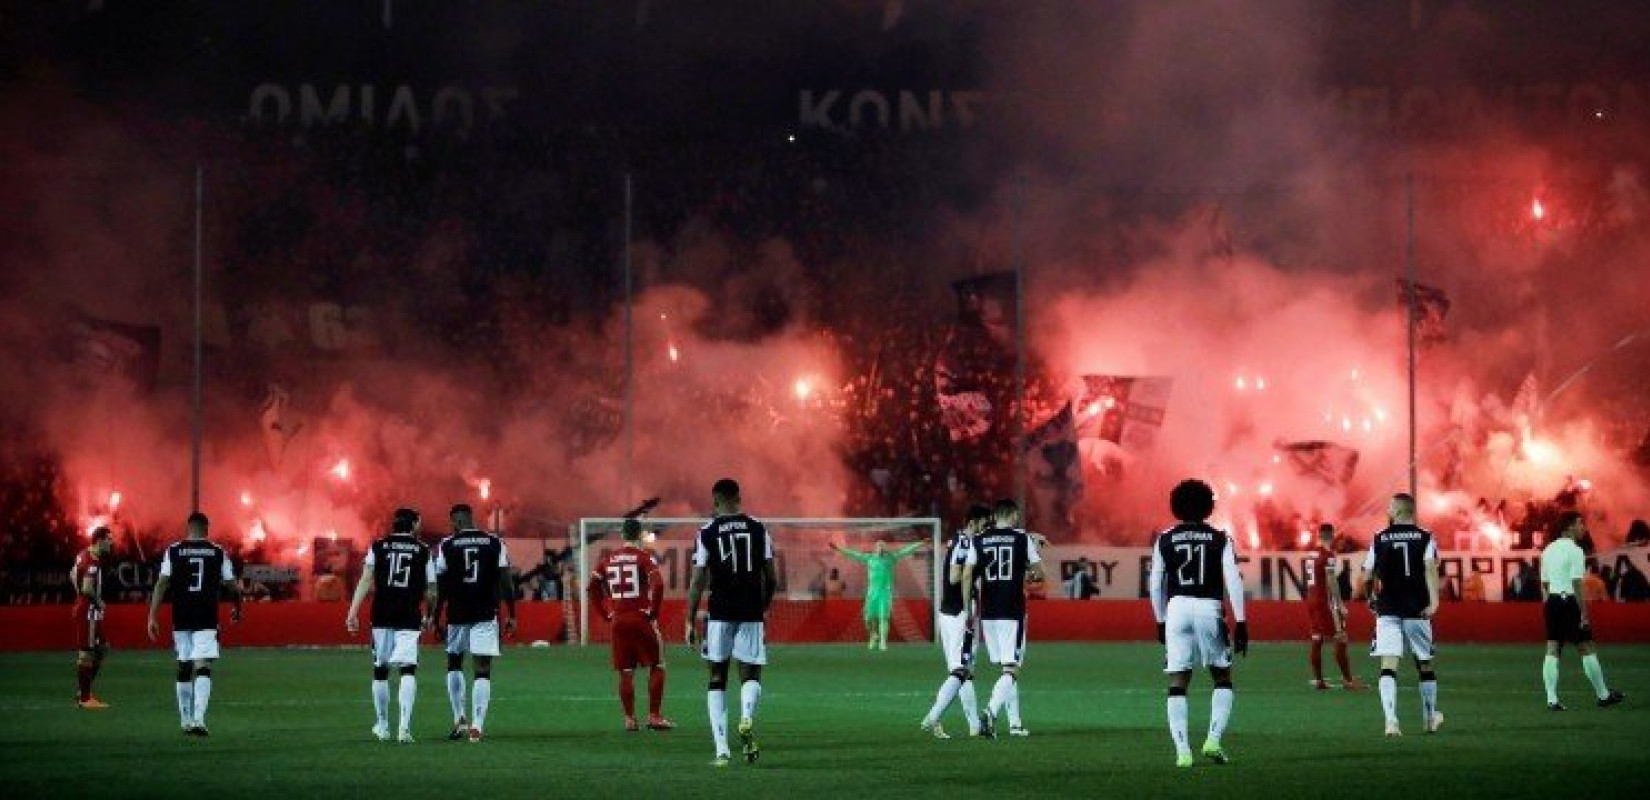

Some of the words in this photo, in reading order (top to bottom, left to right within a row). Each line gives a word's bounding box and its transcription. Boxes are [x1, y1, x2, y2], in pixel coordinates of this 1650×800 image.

[387, 552, 412, 588] 15
[462, 547, 479, 583] 5
[717, 533, 752, 573] 47
[1174, 543, 1205, 585] 21
[1391, 541, 1411, 577] 7
[187, 557, 204, 592] 3
[605, 563, 640, 598] 23
